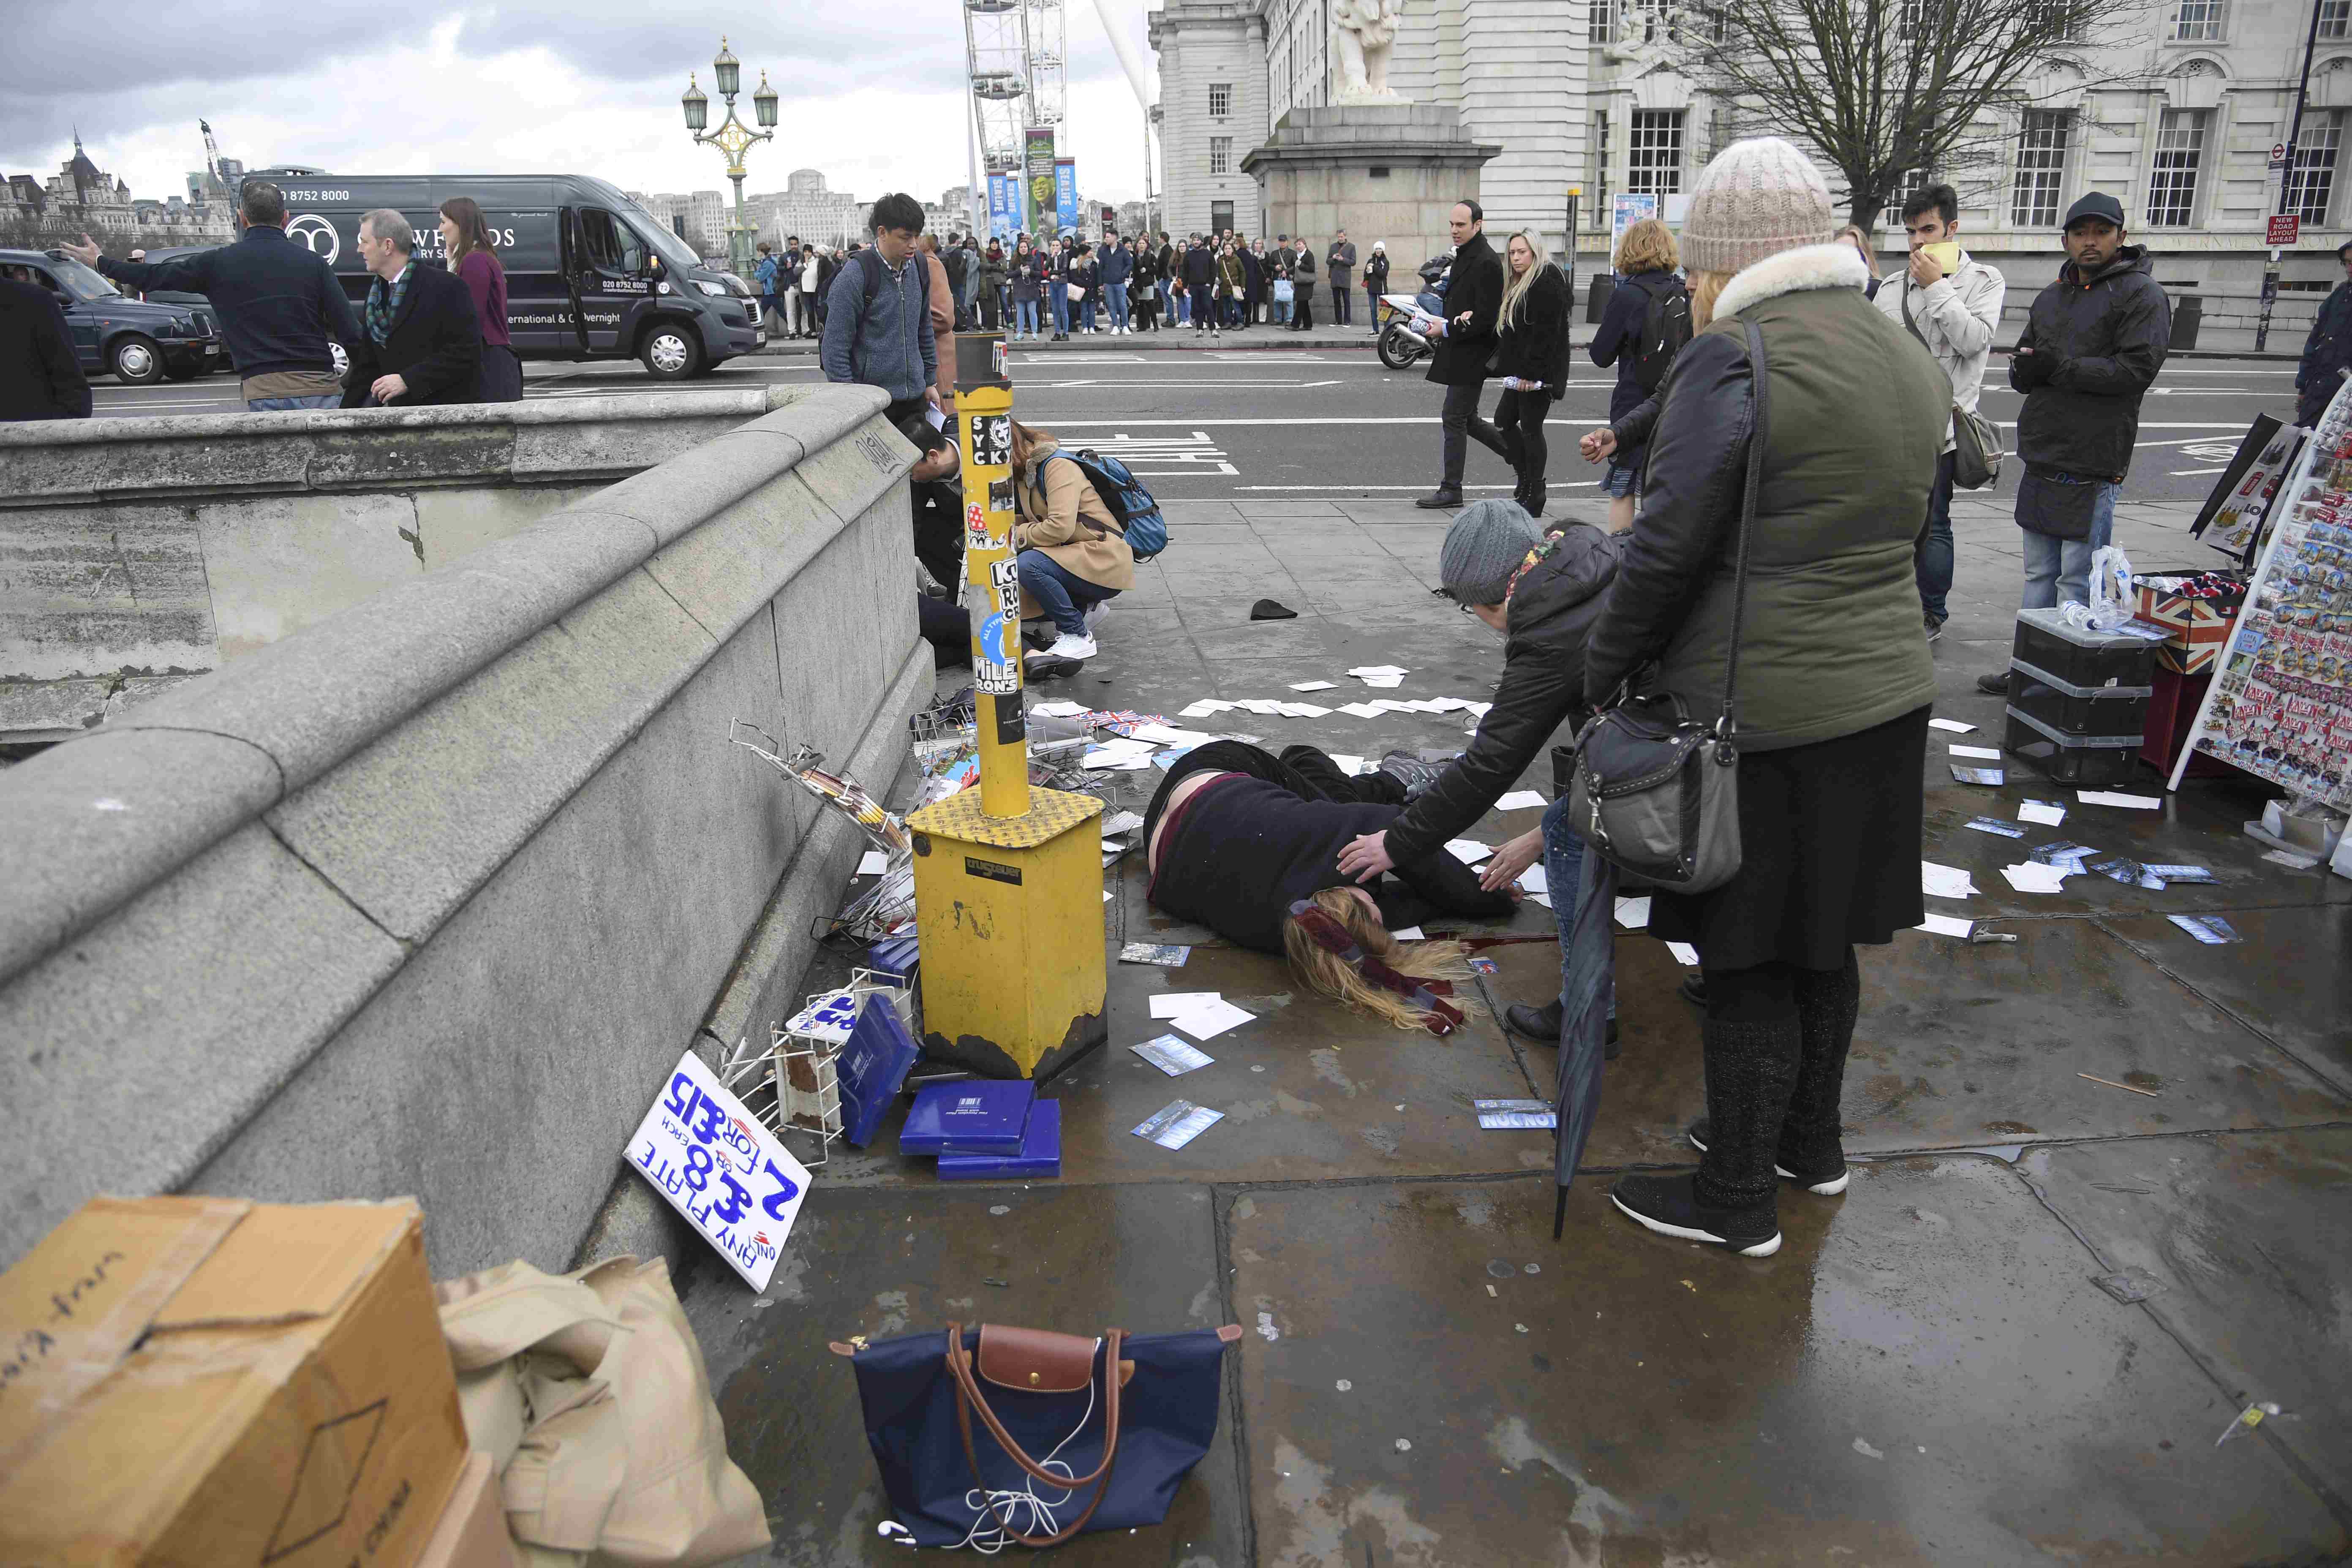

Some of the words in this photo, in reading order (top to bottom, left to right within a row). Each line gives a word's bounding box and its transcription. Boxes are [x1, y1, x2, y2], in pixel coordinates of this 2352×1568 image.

[290, 191, 317, 201] 8752
[321, 191, 349, 200] 8000
[2147, 235, 2264, 250] GOVERNMEN
[2299, 235, 2336, 250] ROM
[558, 314, 565, 323] &
[976, 678, 1016, 693] RON'S
[664, 1072, 726, 1144] £15
[662, 1116, 689, 1146] EACH
[723, 1116, 761, 1176] FOR
[716, 1149, 732, 1173] OR
[637, 1141, 712, 1228] PLATE
[683, 1143, 753, 1224] £8
[762, 1158, 799, 1221] 2
[716, 1226, 757, 1269] ANY
[749, 1235, 776, 1261] ONLY
